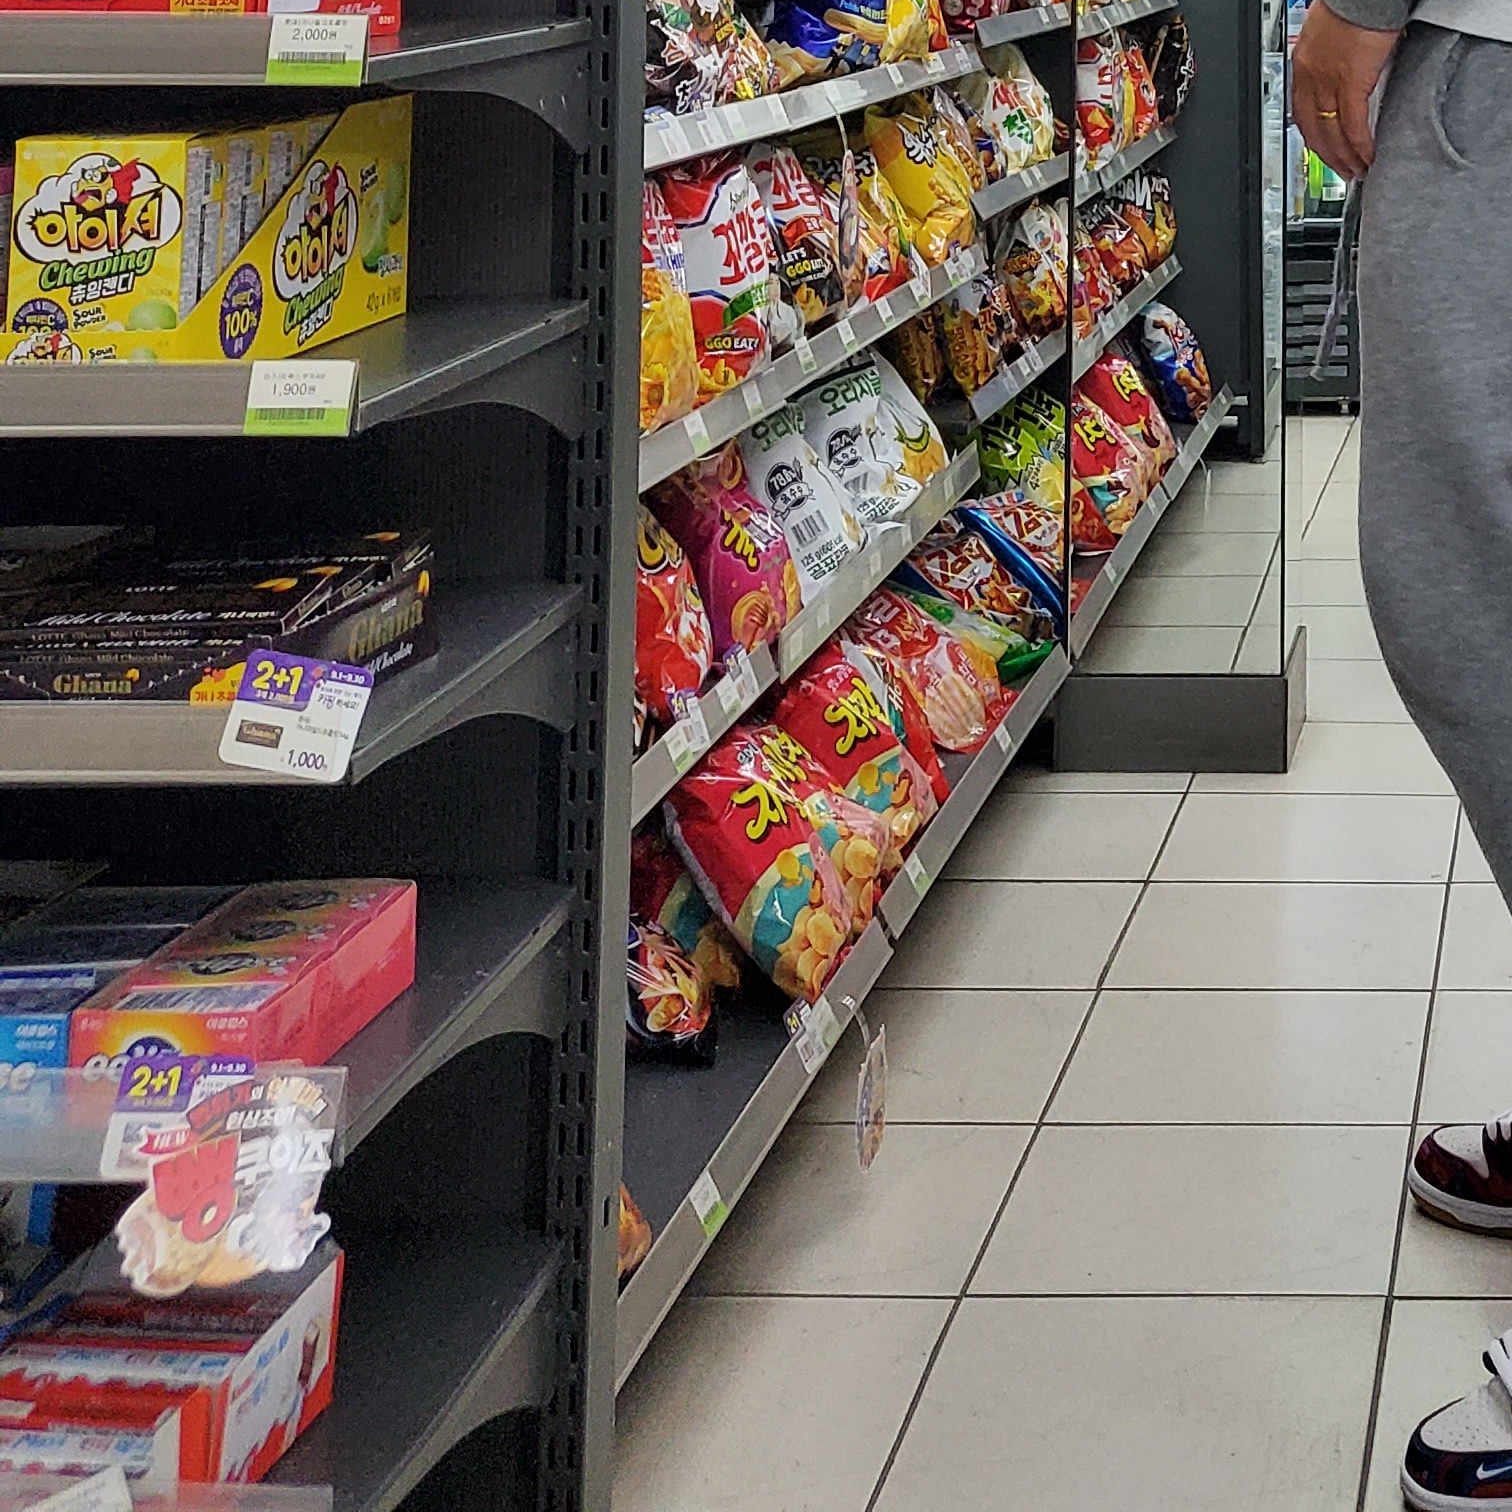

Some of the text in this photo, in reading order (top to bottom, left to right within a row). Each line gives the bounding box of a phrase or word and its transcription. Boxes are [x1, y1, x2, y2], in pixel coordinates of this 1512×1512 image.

[291, 27, 337, 41] 2,000원
[30, 185, 166, 253] 아이셔
[40, 246, 157, 291] Chewing
[780, 246, 808, 265] LET'S
[225, 308, 258, 339] 100%
[732, 335, 760, 351] EAT!
[271, 382, 316, 397] 1,900원
[98, 607, 212, 623] Chocolate
[348, 599, 425, 662] Ghana
[52, 672, 133, 695] Ghana
[252, 661, 305, 695] 2+1
[130, 1065, 183, 1097] 2+1
